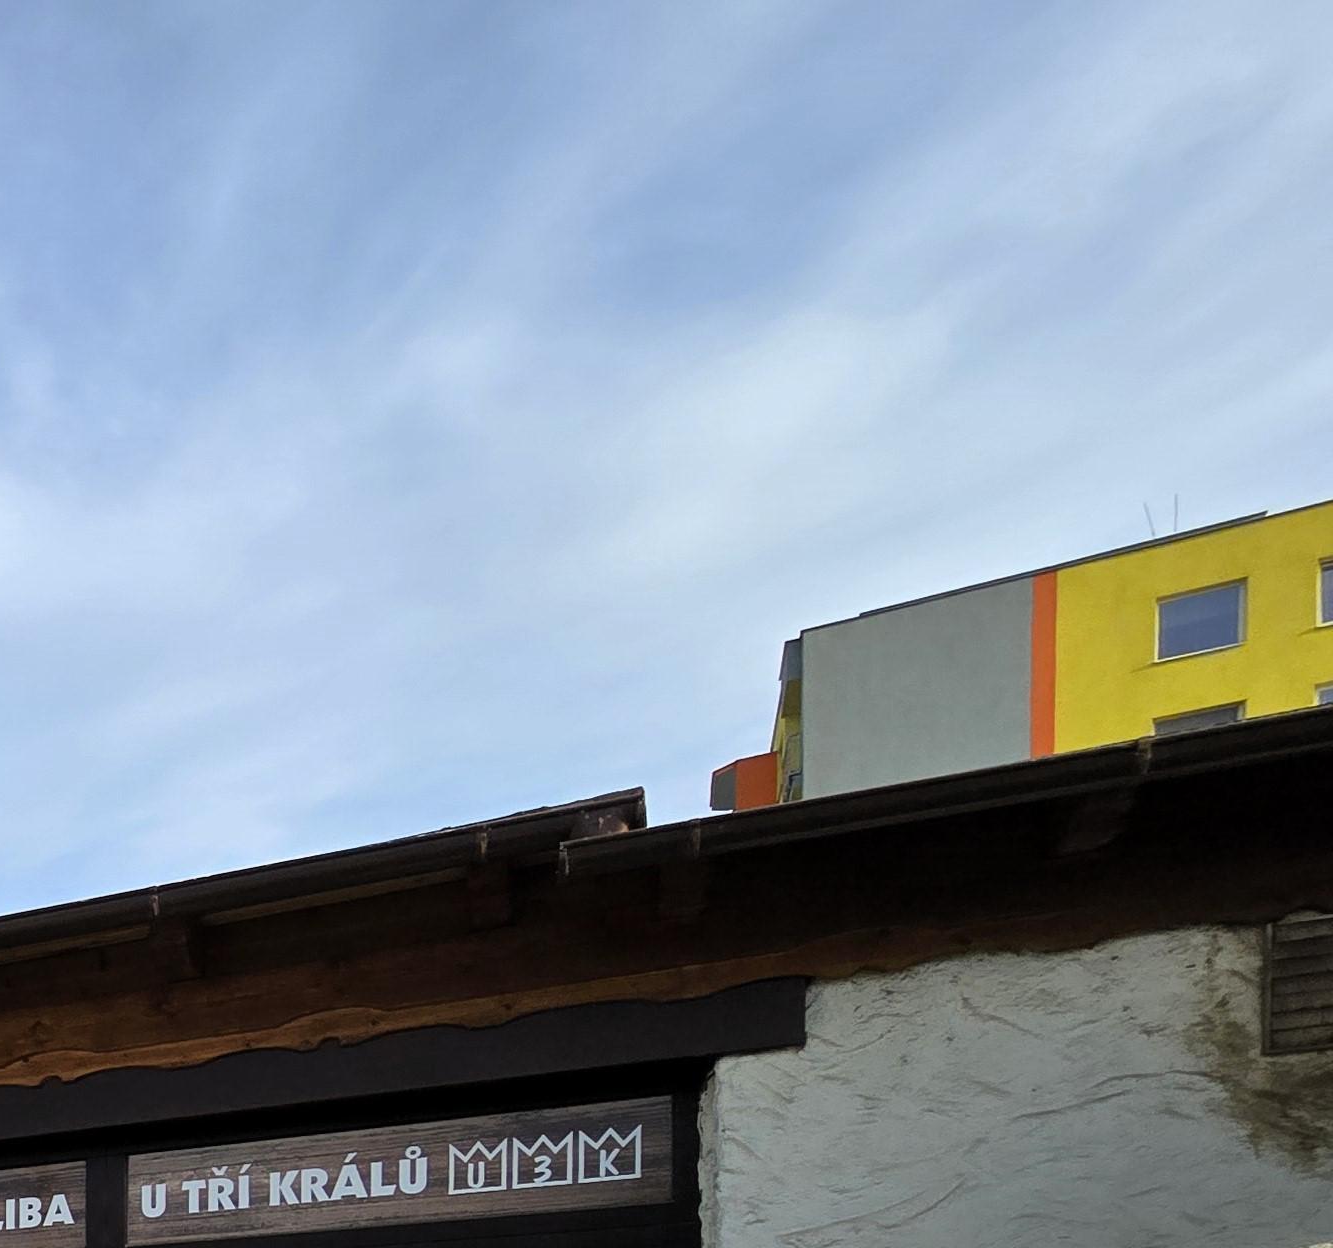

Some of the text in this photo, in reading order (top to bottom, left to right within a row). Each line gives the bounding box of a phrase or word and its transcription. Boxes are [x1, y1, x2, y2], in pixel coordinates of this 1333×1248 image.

[140, 1145, 429, 1218] U TŘÍ KRÁLŮ
